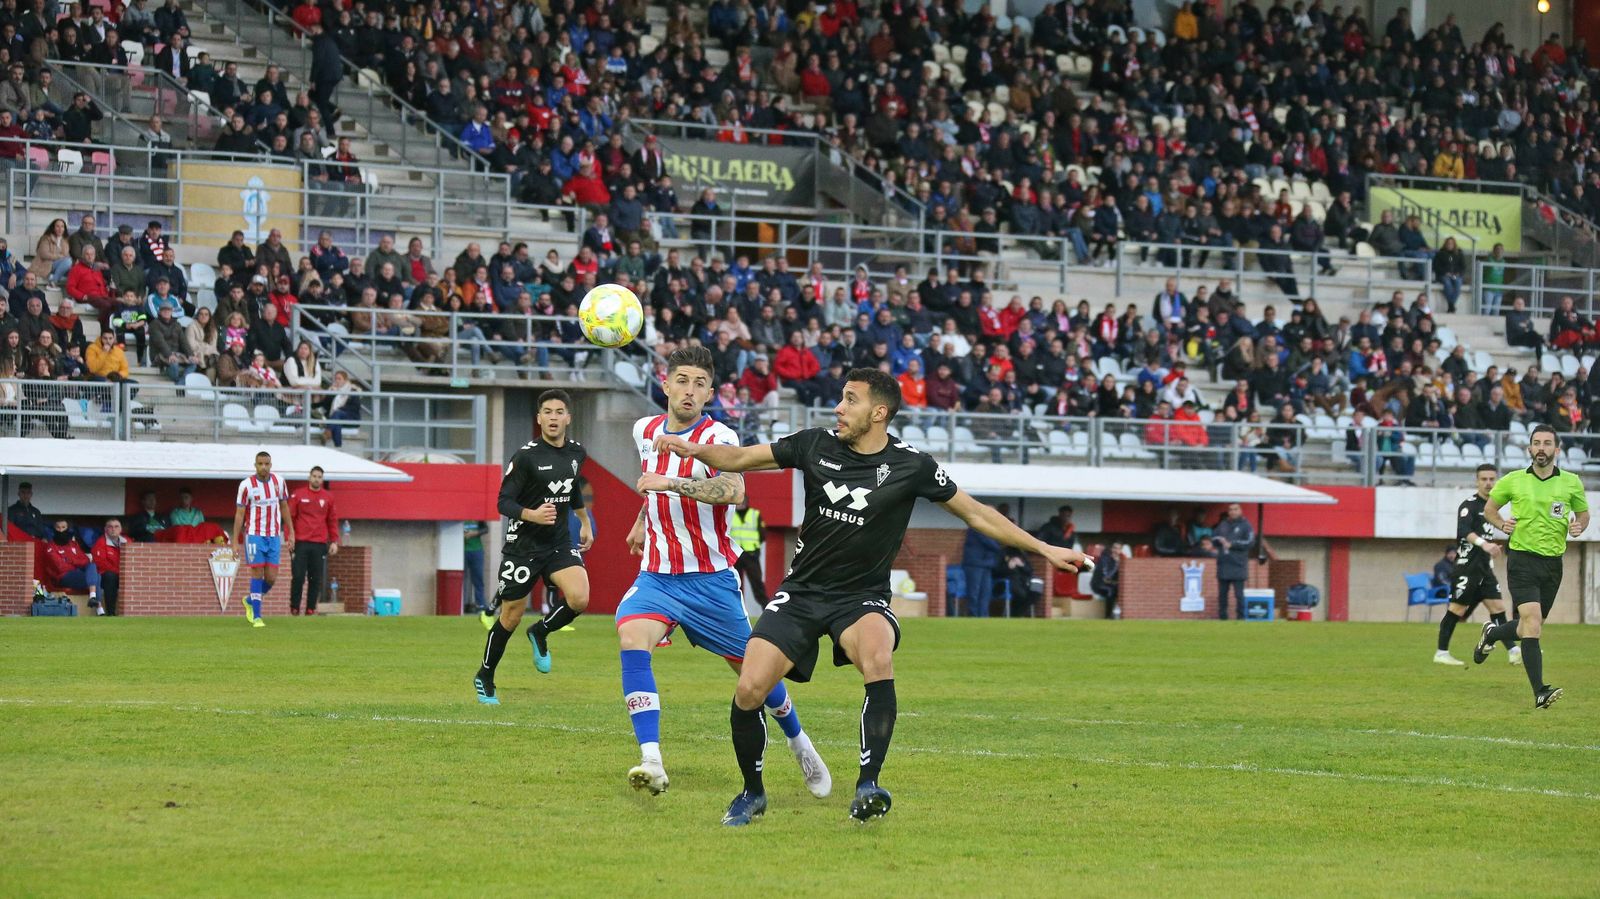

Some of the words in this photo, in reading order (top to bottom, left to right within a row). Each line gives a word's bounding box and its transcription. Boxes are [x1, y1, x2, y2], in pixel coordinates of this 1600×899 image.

[818, 458, 842, 471] hummel
[818, 505, 865, 526] VERSUS
[248, 543, 257, 555] 11
[501, 561, 530, 583] 20
[1456, 576, 1468, 590] 2
